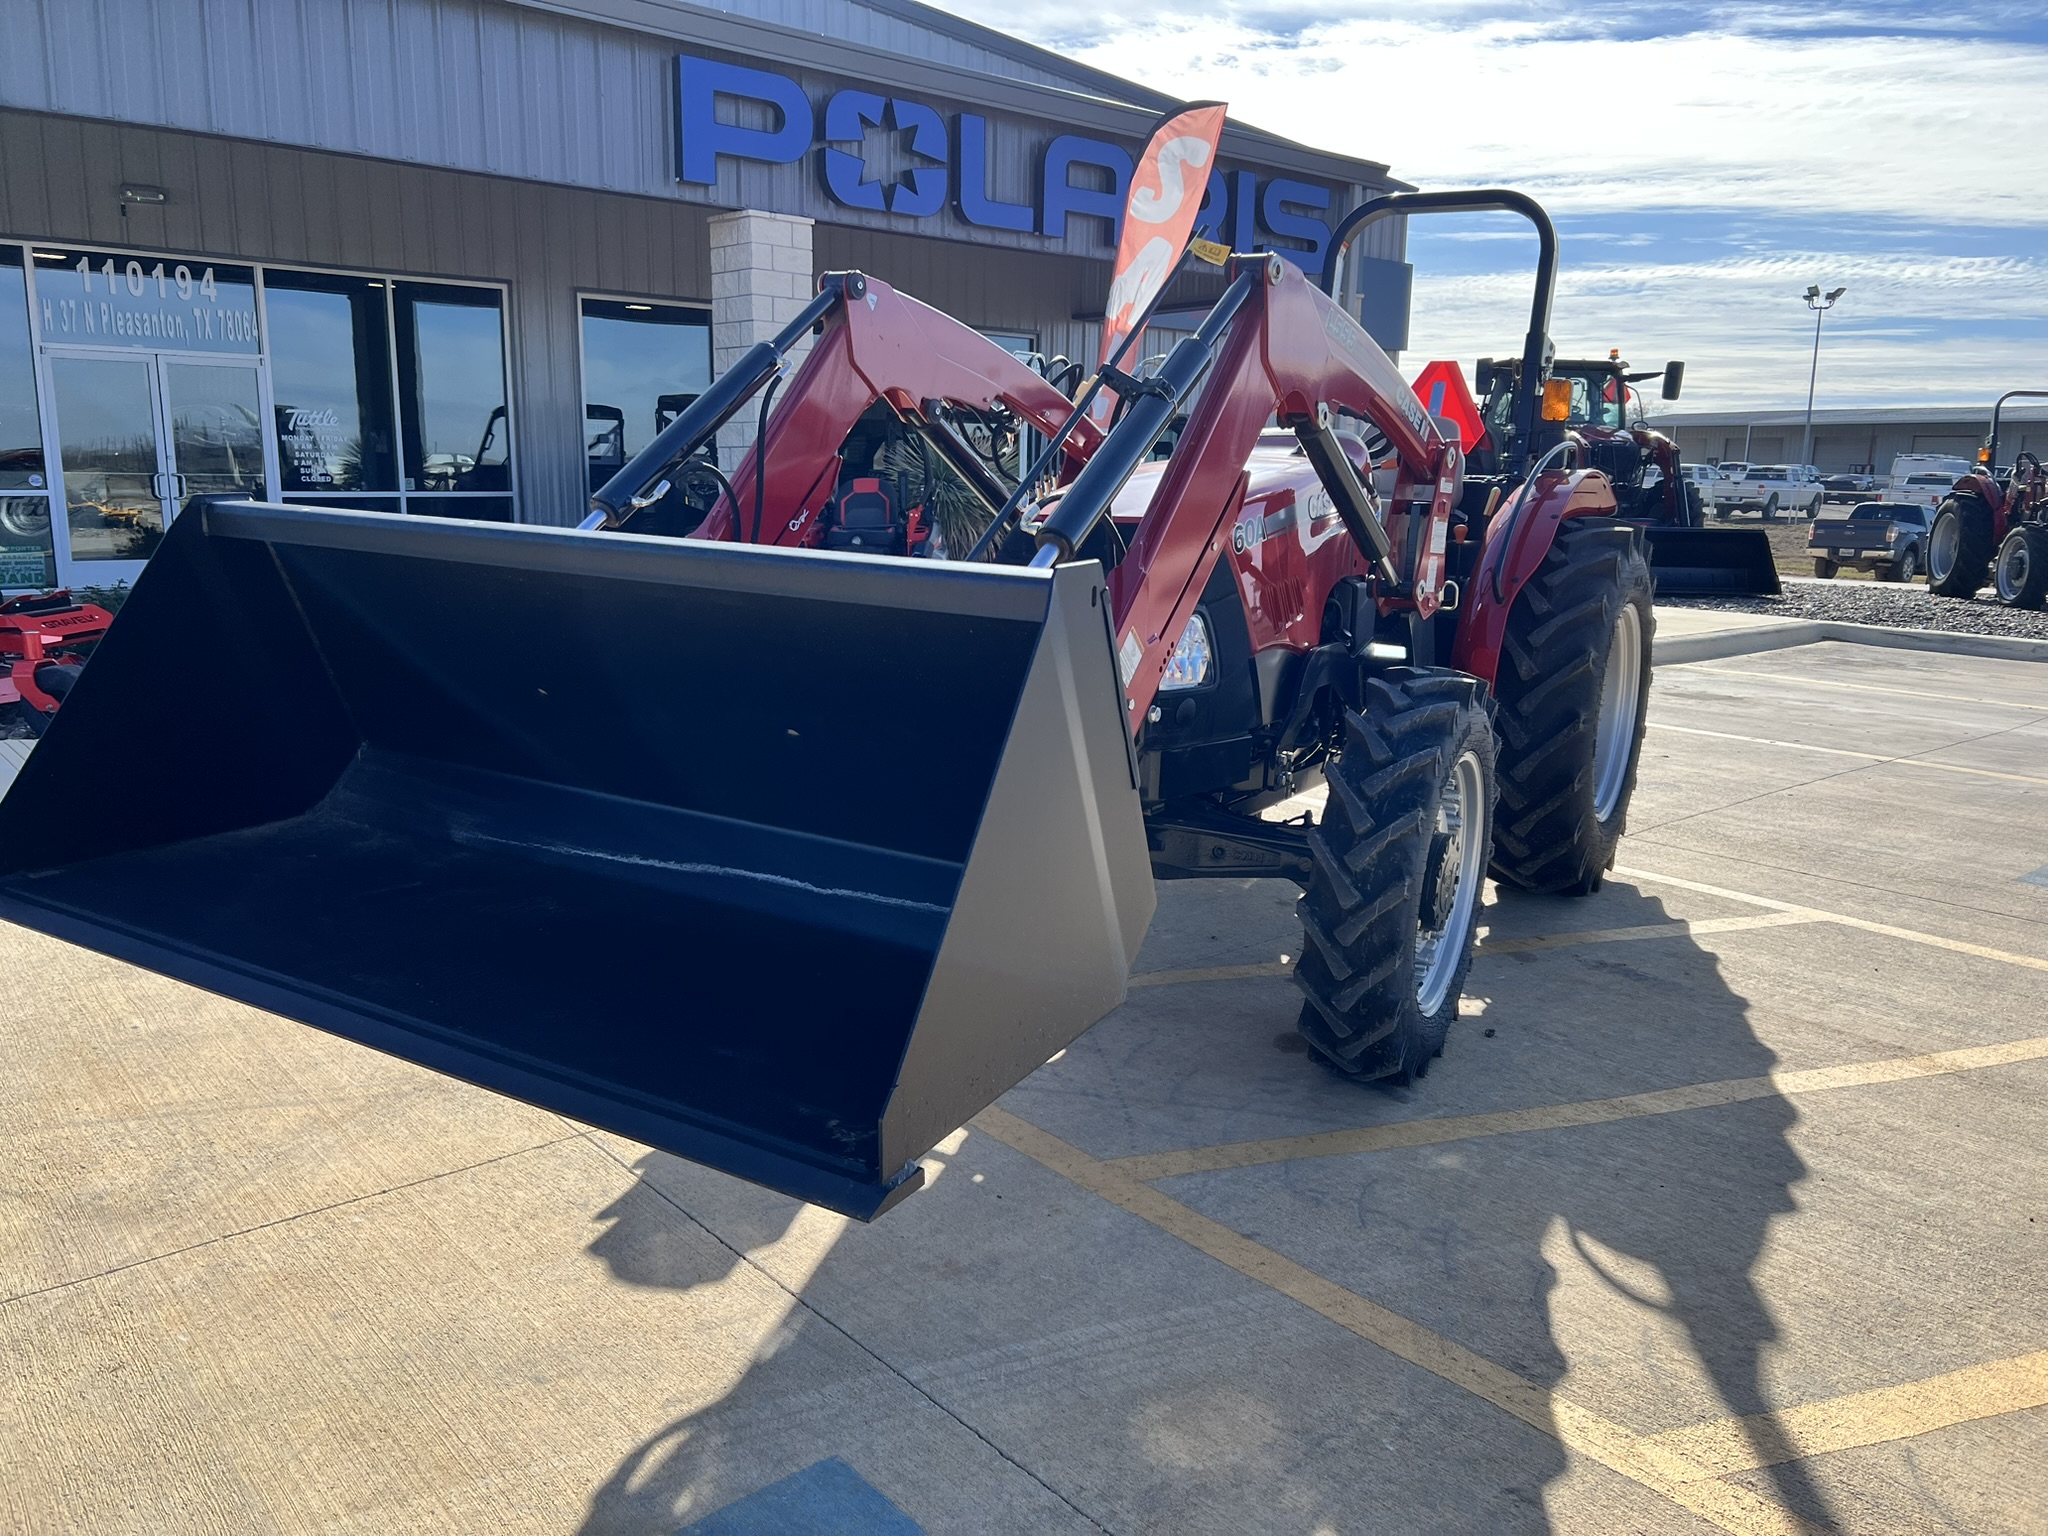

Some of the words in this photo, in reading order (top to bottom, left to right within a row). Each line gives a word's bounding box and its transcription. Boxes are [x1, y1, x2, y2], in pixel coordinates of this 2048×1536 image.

[76, 256, 217, 302] 110194
[59, 299, 76, 334] 37
[83, 300, 95, 335] N
[100, 301, 190, 346] Pleasanton,
[193, 307, 213, 340] TX
[218, 309, 259, 342] 78064
[286, 408, 339, 431] Tuttle
[1396, 384, 1423, 432] CASE
[1233, 514, 1268, 554] 60A
[43, 614, 97, 630] GRAVELY
